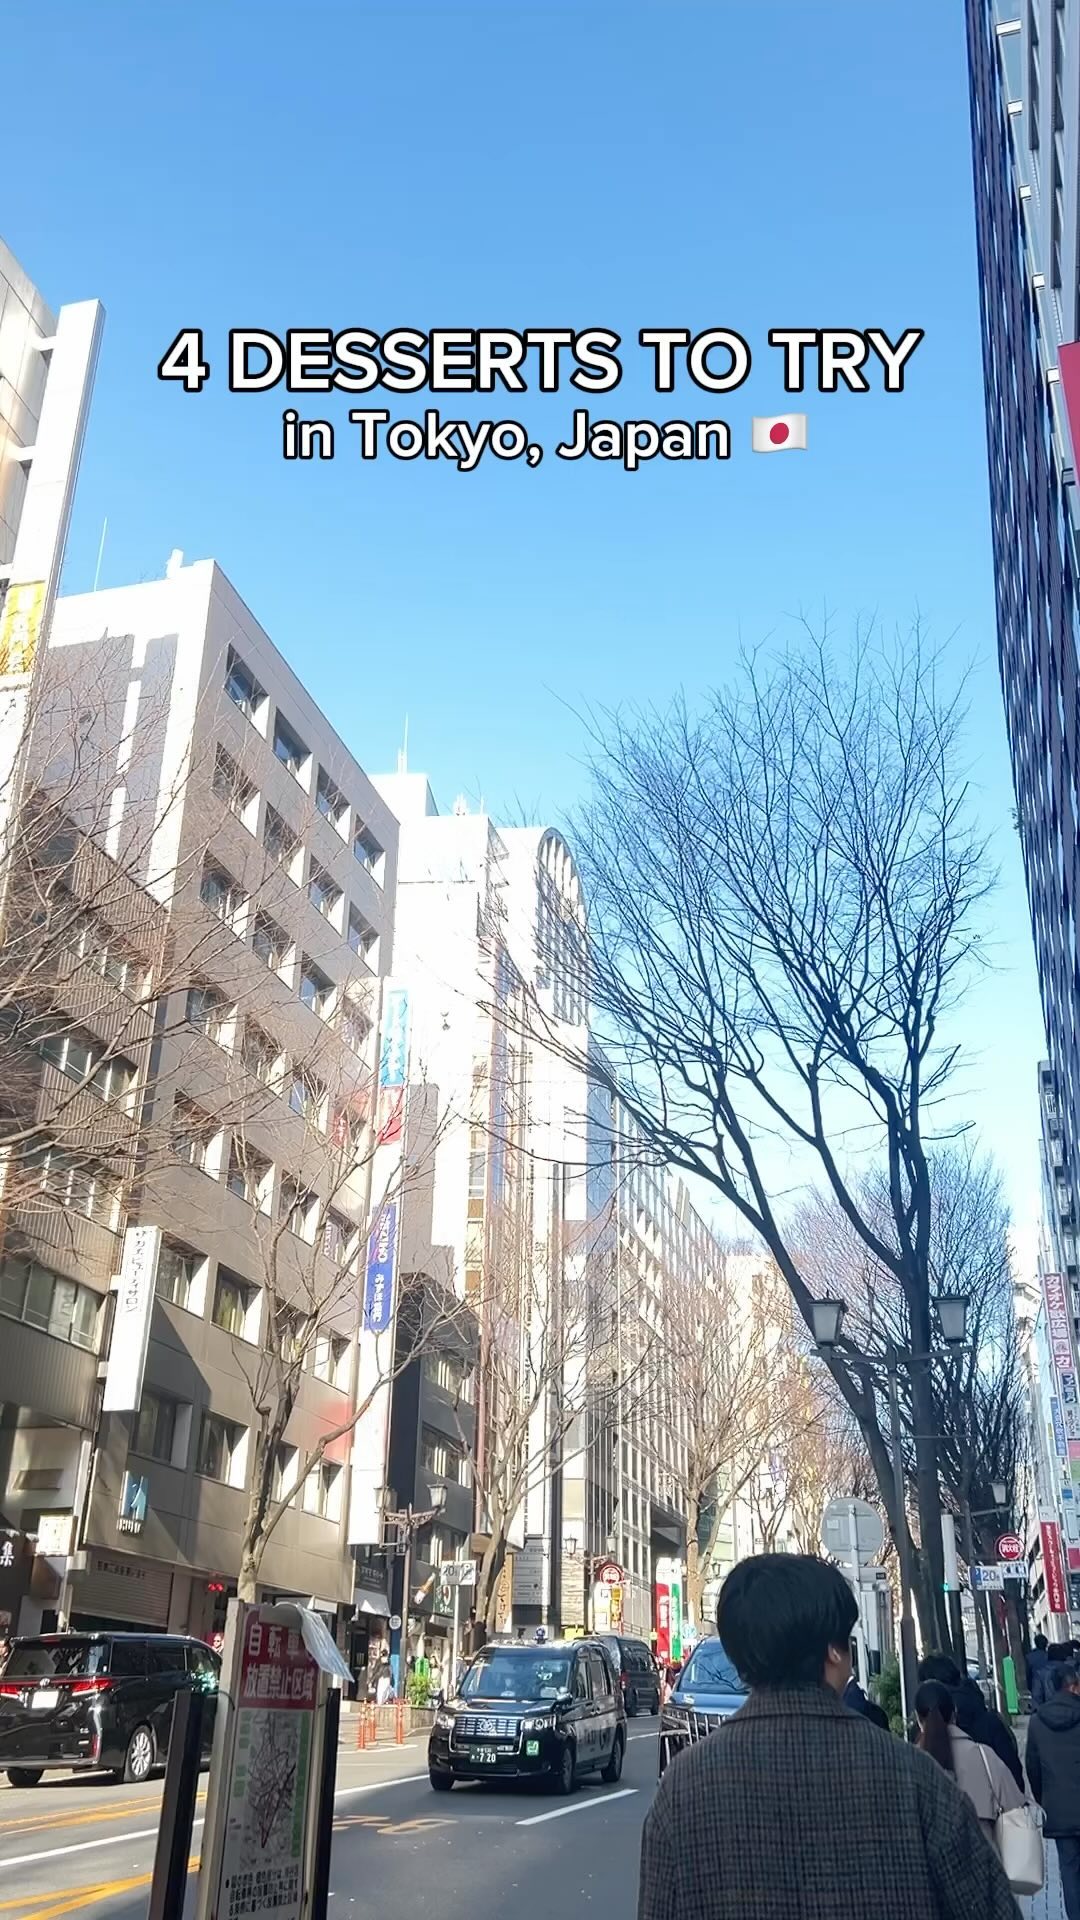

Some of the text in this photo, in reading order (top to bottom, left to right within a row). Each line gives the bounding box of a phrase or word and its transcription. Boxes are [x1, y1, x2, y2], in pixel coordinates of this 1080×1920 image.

[248, 1621, 315, 1662] 自転車
[244, 1663, 315, 1701] 放置禁止区域
